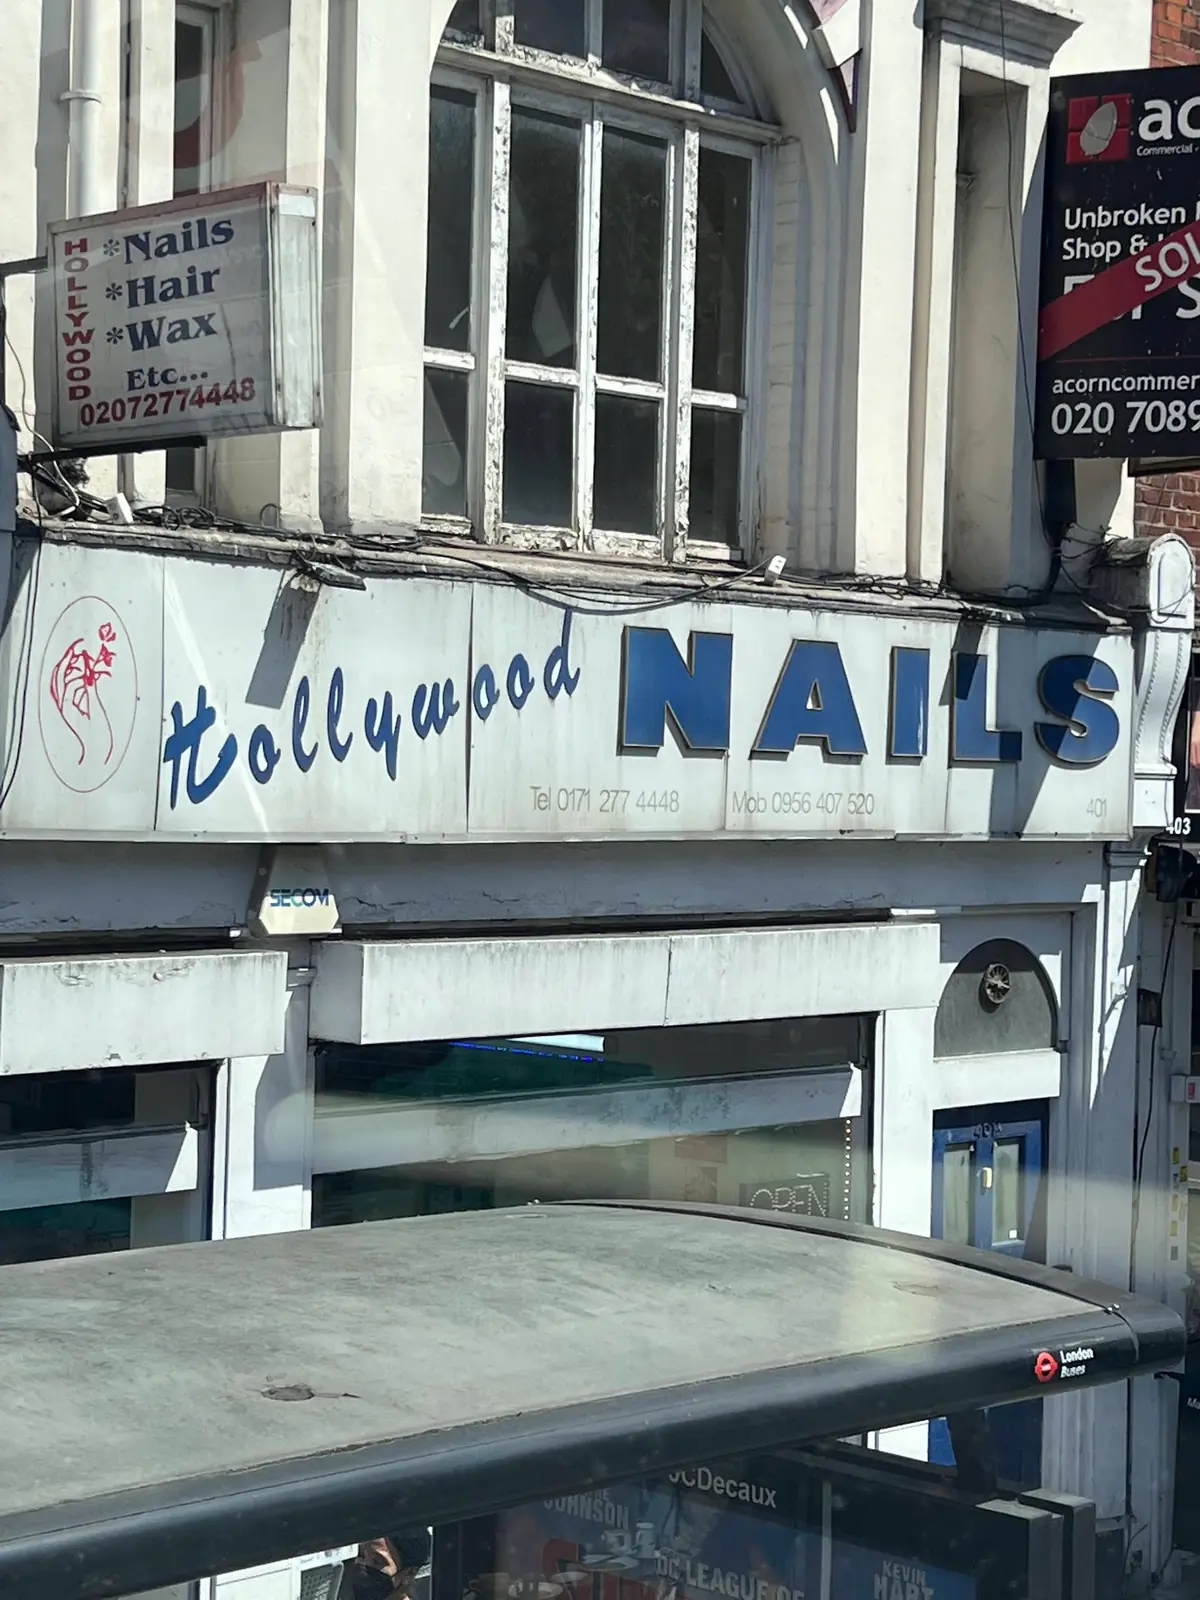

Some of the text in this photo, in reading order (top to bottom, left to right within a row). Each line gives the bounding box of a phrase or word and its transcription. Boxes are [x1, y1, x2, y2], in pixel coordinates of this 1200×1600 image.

[1136, 144, 1193, 156] Commercial
[1065, 203, 1187, 230] Unbroken
[123, 217, 234, 264] Nails
[1062, 237, 1121, 262] Shop
[126, 265, 220, 309] Hair
[62, 237, 95, 401] HOLLYWOOD
[125, 312, 217, 351] Wax
[127, 367, 208, 391] Etc...
[80, 377, 256, 427] 02072774448
[1051, 401, 1115, 435] 020
[163, 608, 1120, 810] Hollywood NAILS
[530, 786, 679, 814] Tel 0171 277 4448
[732, 790, 875, 815] Mob 0956 407 520
[1086, 797, 1107, 818] 401
[270, 887, 330, 907] SECOM
[1060, 1347, 1094, 1364] London
[1060, 1363, 1086, 1379] Buses
[882, 1559, 927, 1588] KEVIN
